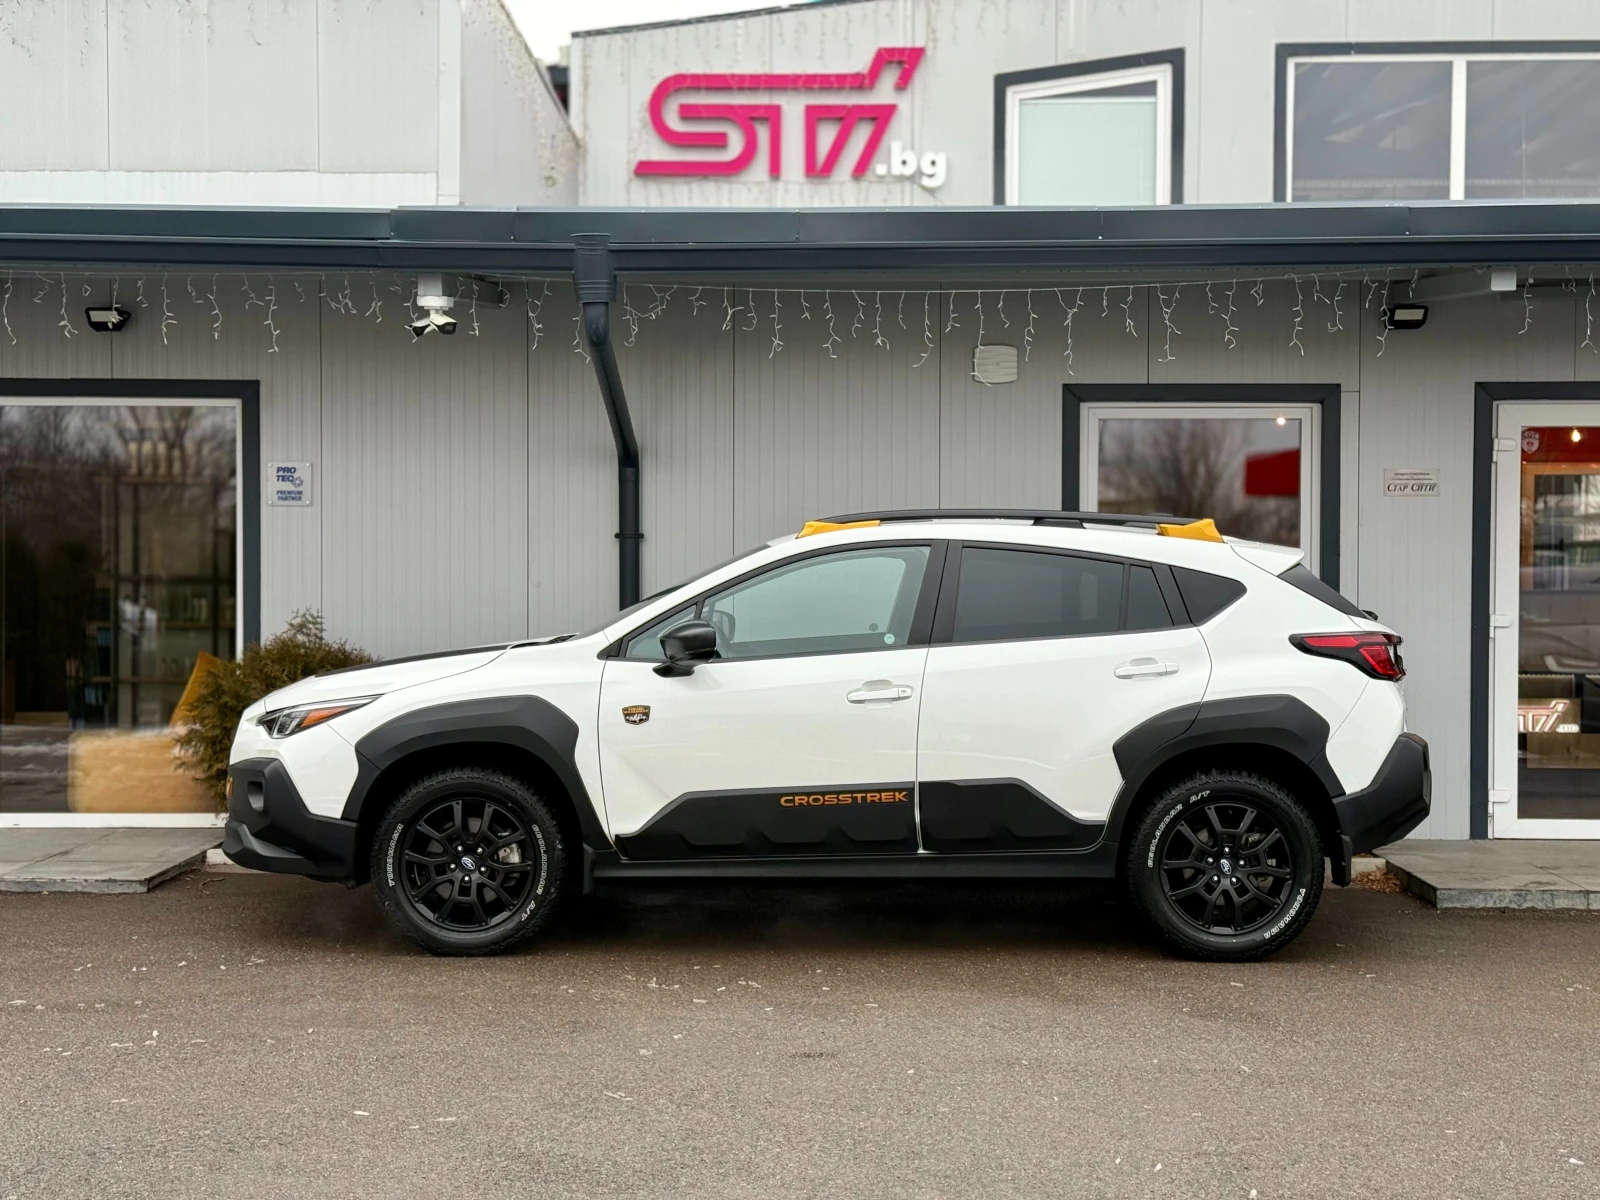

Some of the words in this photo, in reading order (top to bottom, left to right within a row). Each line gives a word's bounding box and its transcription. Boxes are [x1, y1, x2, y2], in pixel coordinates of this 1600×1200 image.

[275, 474, 295, 483] TEC
[276, 466, 297, 475] PRO
[780, 790, 910, 807] CROSSTREK
[386, 823, 404, 887] YOKOHAMA
[1147, 803, 1184, 868] GEOLANDAR
[1189, 790, 1211, 803] A/T
[531, 824, 548, 896] GEOLANDAR
[1263, 888, 1307, 940] YOKOHAMA
